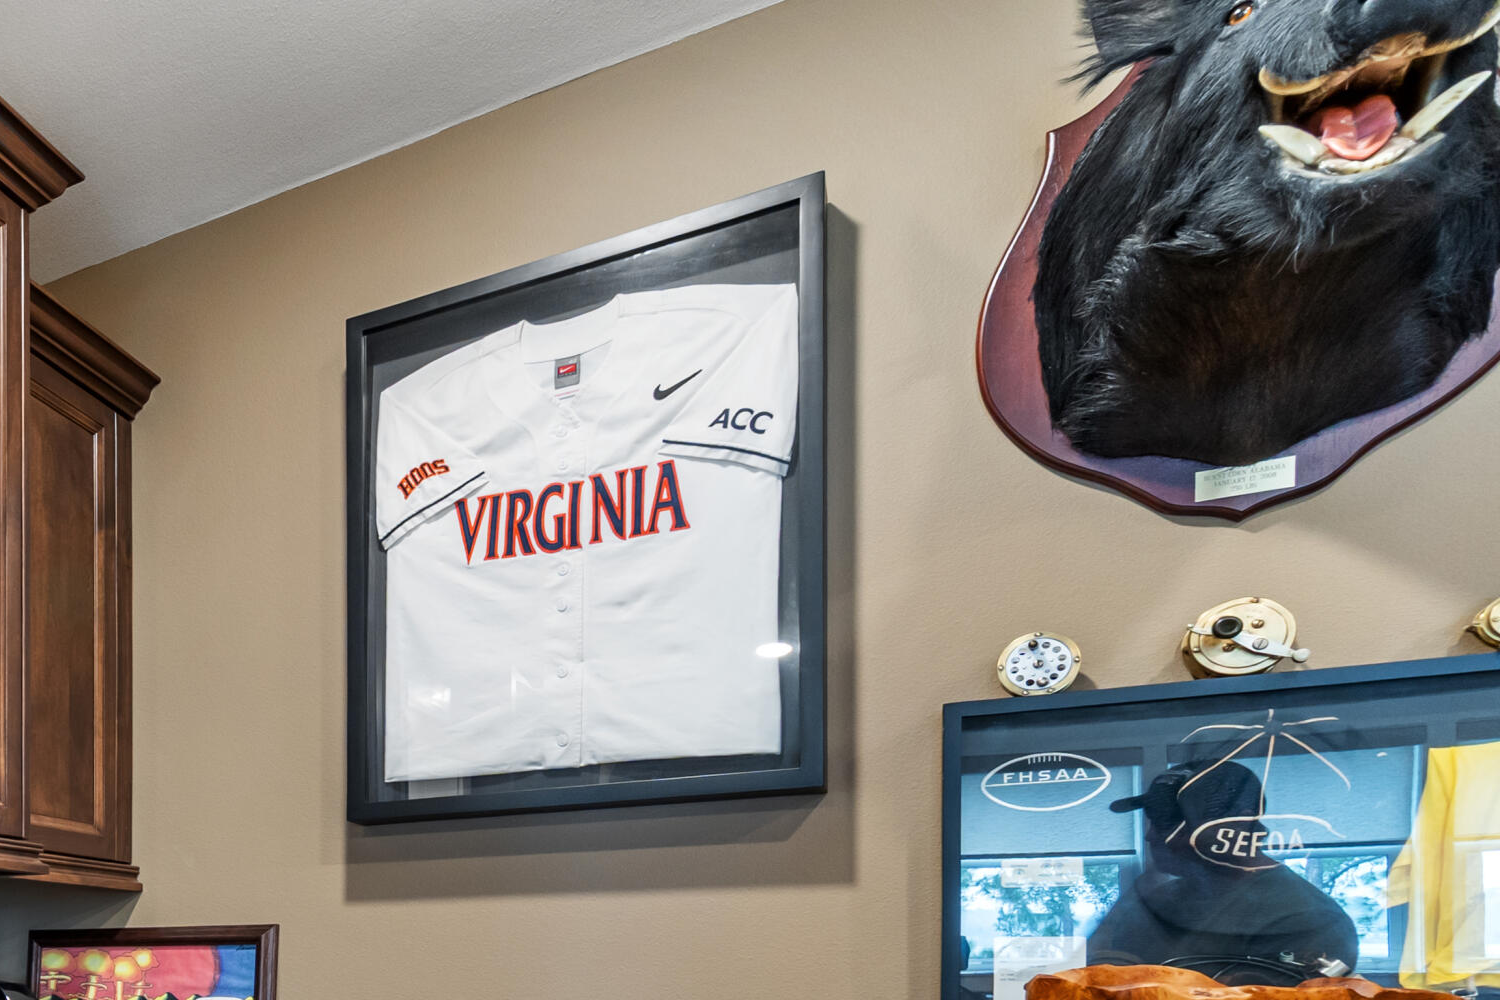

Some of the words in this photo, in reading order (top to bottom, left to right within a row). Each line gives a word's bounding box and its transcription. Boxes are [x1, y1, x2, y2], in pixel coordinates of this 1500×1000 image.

[708, 406, 773, 435] ACC
[396, 458, 450, 500] HOOS
[454, 458, 691, 565] VIRGINIA
[1003, 768, 1088, 784] FHSAA
[1211, 828, 1304, 857] SEFOA
